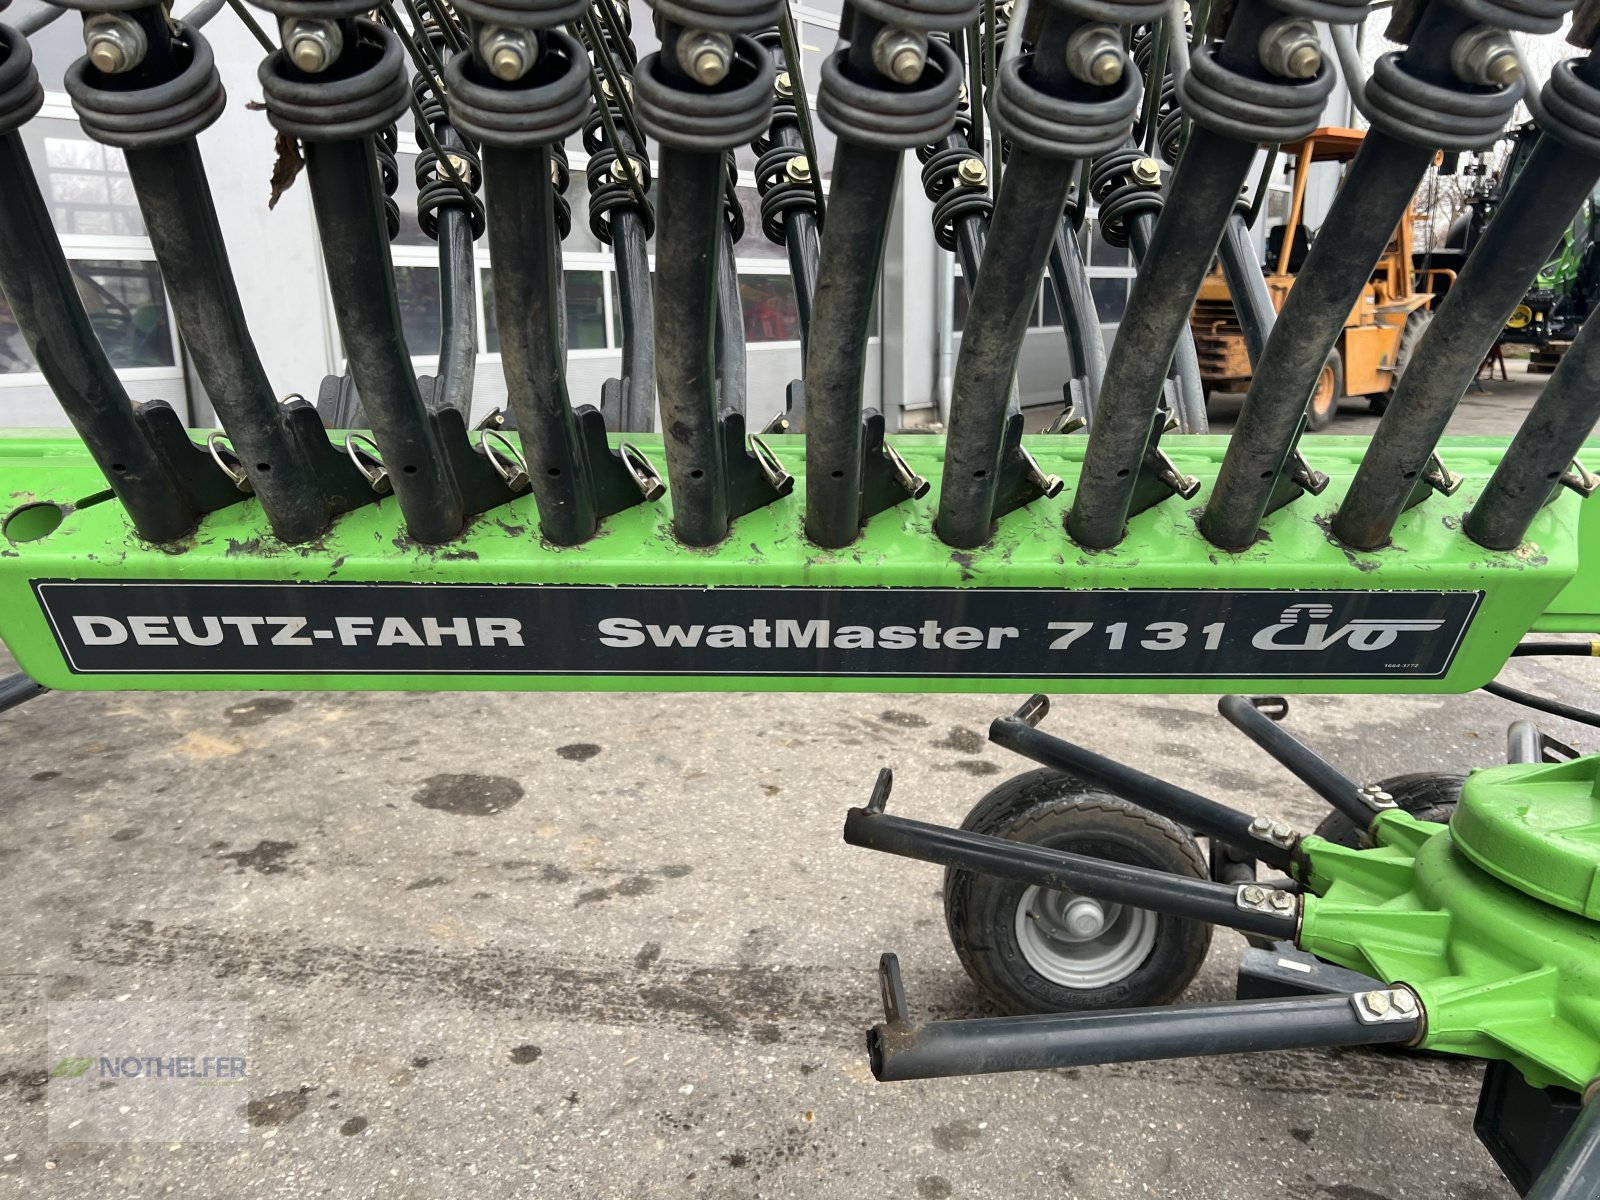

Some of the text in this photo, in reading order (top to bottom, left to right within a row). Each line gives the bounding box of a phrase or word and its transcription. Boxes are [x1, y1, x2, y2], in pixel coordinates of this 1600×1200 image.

[72, 616, 525, 647] DEUTZ-FAHR
[597, 618, 1020, 650] SwatMaster
[1047, 621, 1226, 651] 7131
